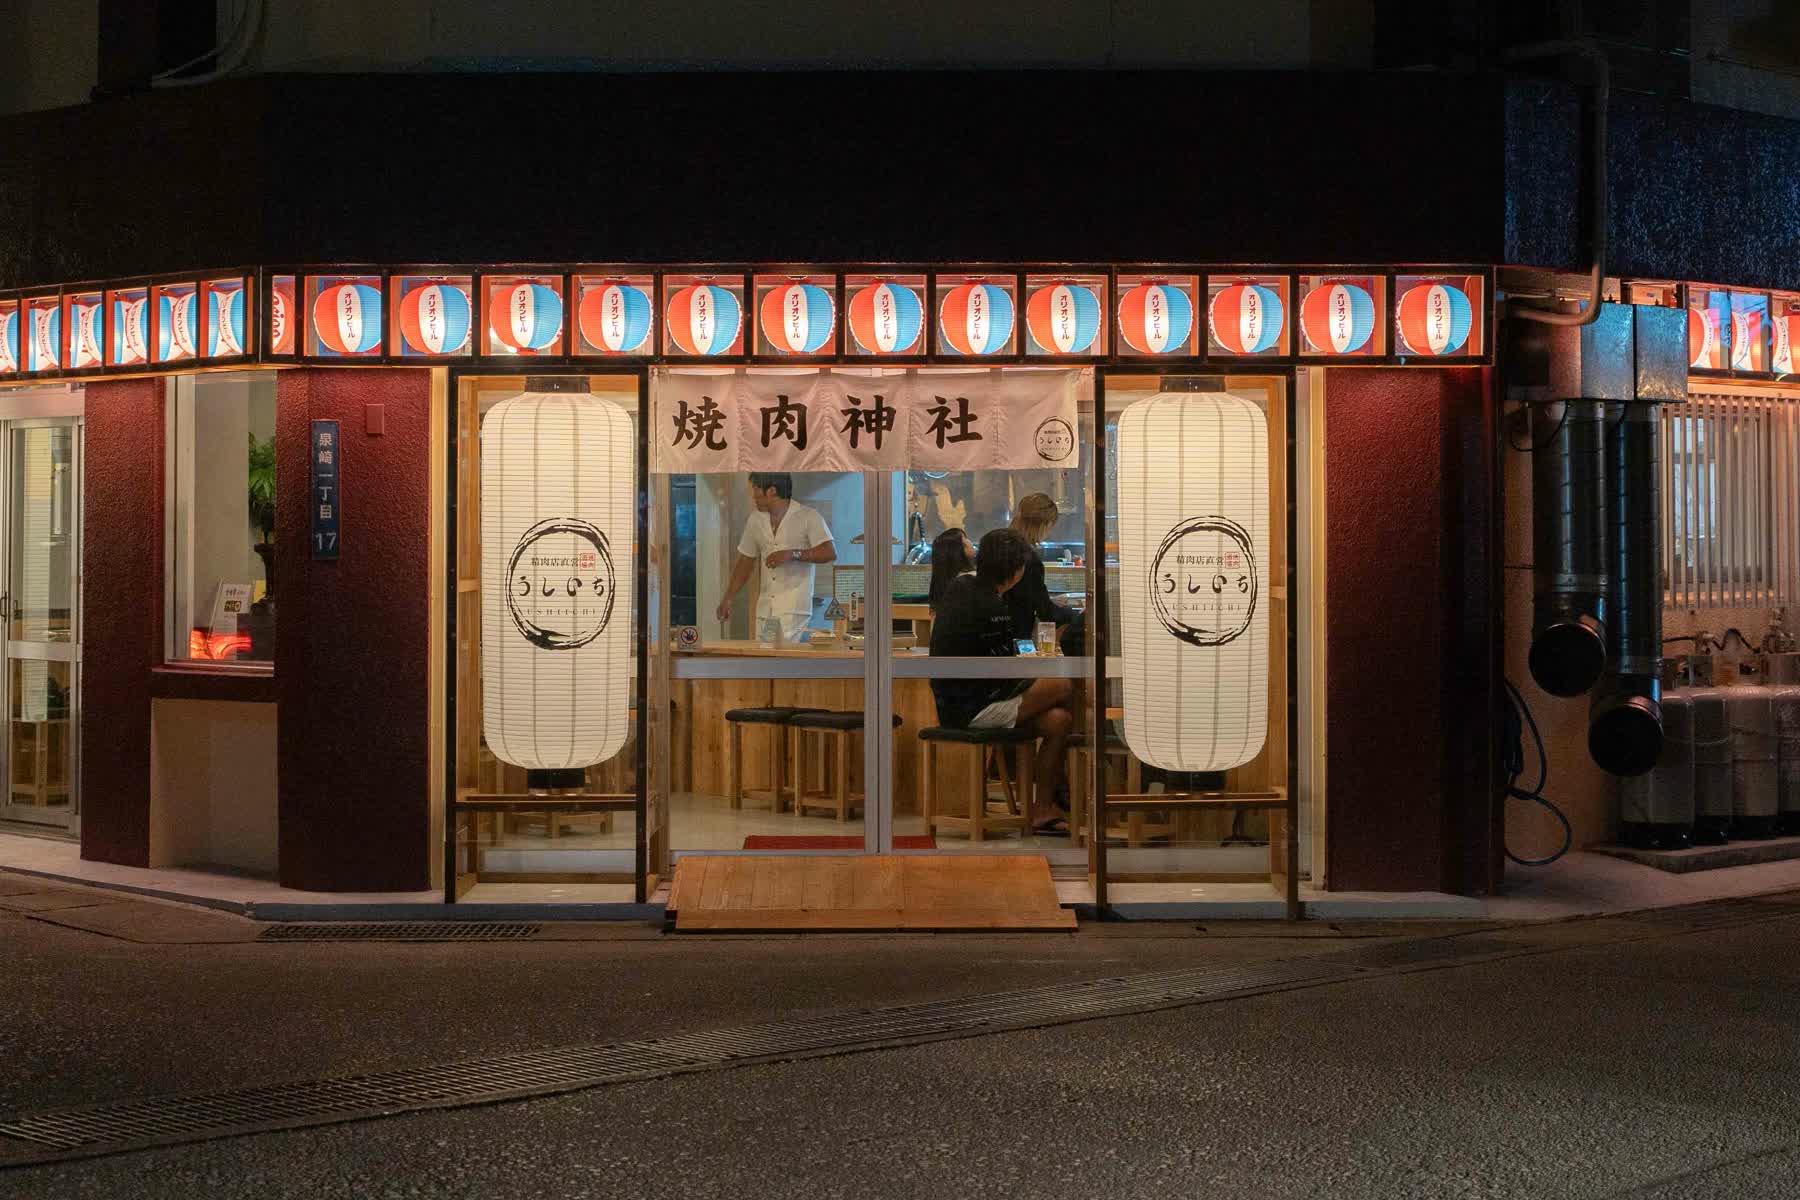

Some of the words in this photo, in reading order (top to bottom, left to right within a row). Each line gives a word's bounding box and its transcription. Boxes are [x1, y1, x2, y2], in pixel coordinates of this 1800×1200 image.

[344, 292, 355, 339] オリオンビール
[427, 293, 439, 341] オリオンビール
[518, 290, 529, 334] オリオンビール
[610, 292, 620, 339] オリオンビール
[698, 293, 708, 341] オリオンビール
[791, 293, 801, 340] オリオンビール
[881, 293, 891, 340] オリオンビール
[973, 293, 982, 340] オリオンビール
[1060, 294, 1070, 341] オリオンビール
[1152, 294, 1162, 340] オリオンビール
[1248, 294, 1257, 340] オリオンビール
[1336, 293, 1346, 340] オリオンビール
[1433, 293, 1443, 340] オリオンビール
[671, 394, 984, 451] 焼肉神社
[318, 432, 334, 520] 泉崎一丁目
[314, 532, 337, 550] 17
[517, 575, 605, 597] うしいち
[1161, 573, 1249, 594] うしいち
